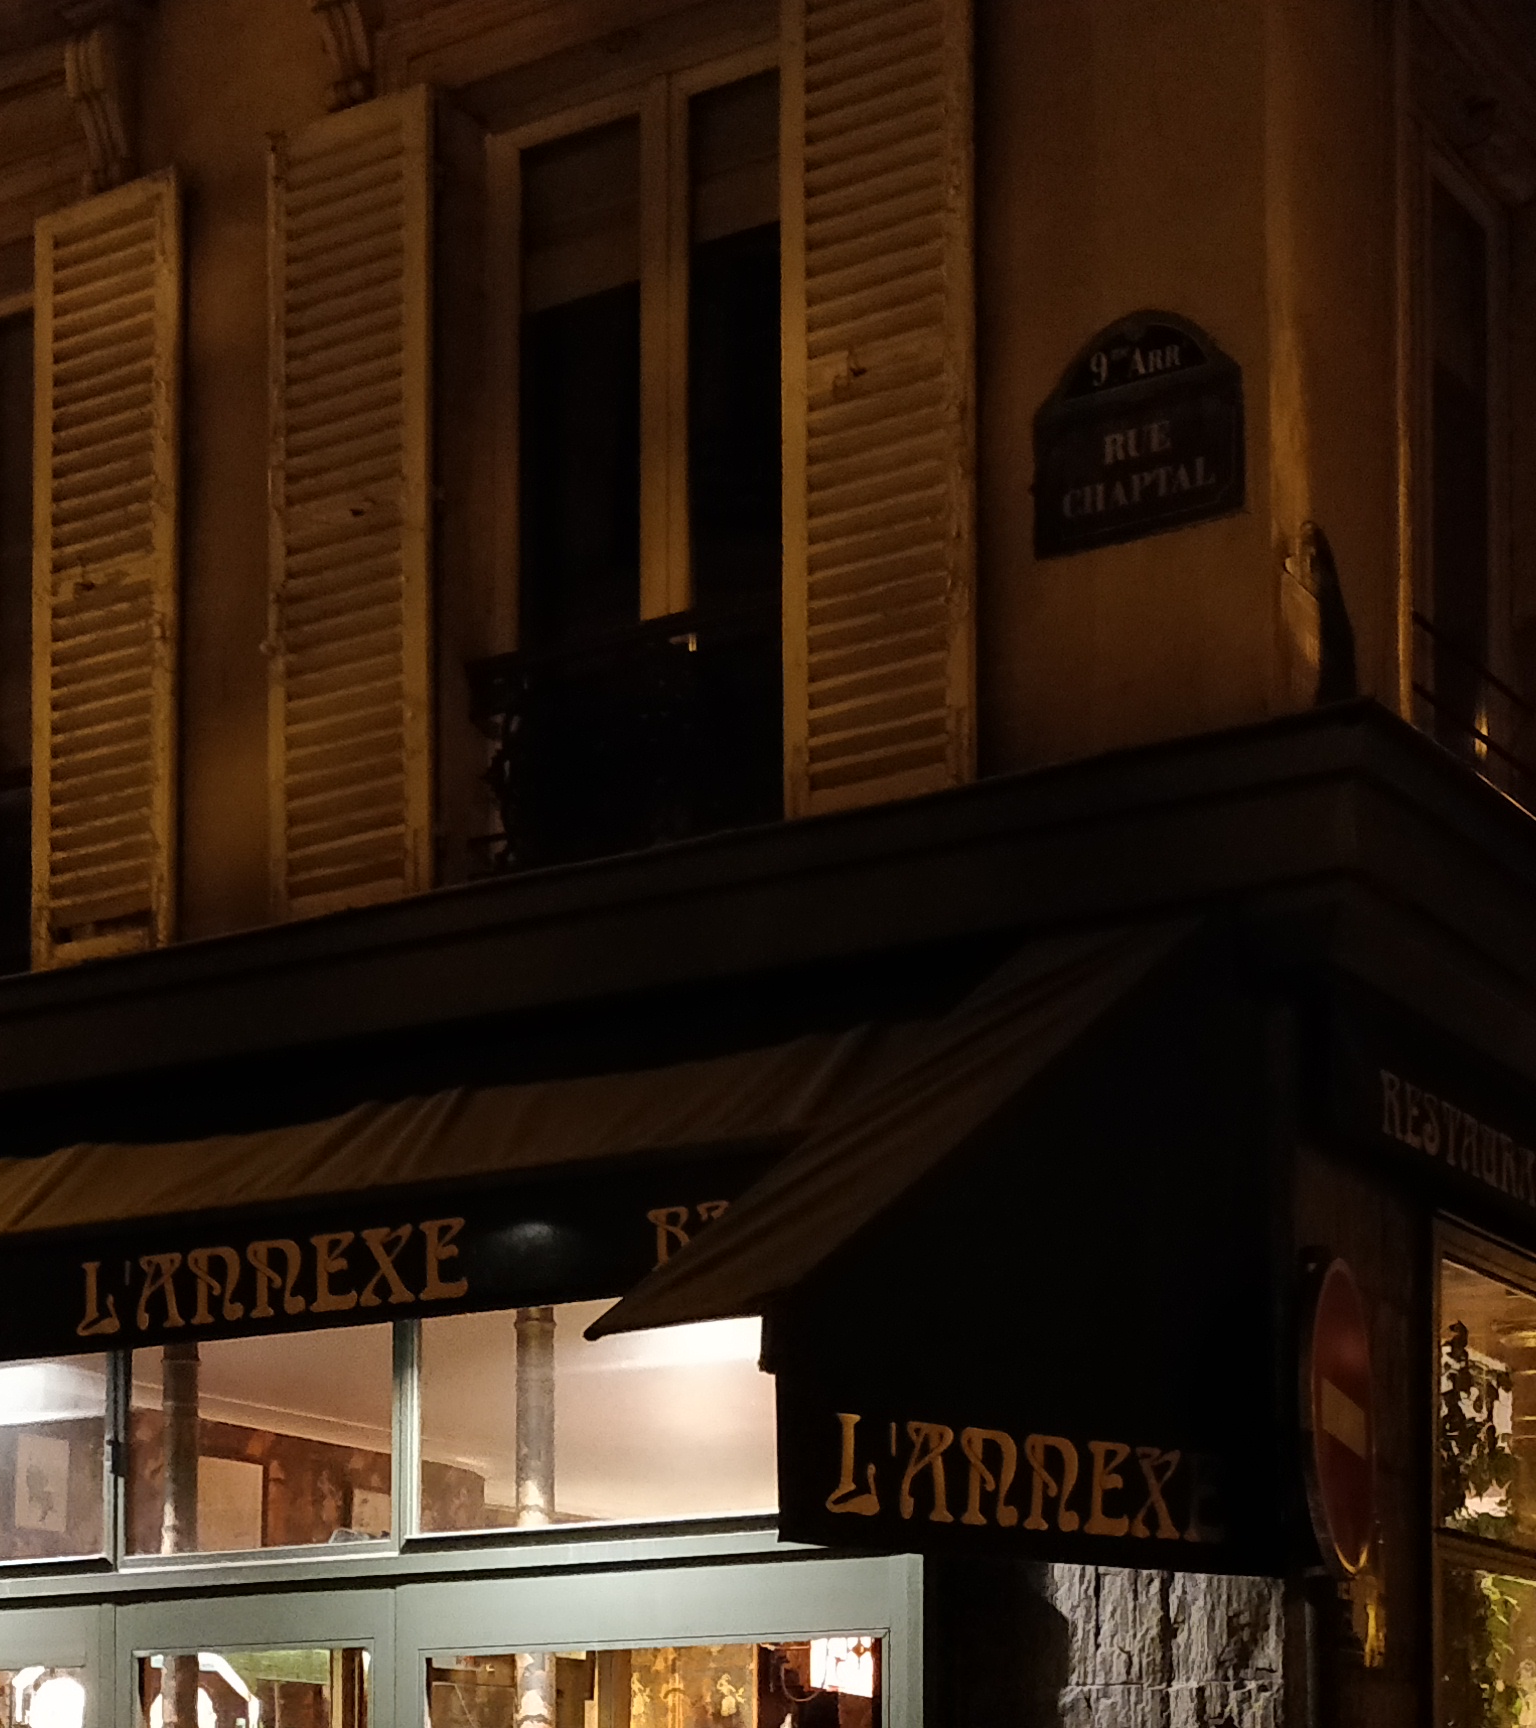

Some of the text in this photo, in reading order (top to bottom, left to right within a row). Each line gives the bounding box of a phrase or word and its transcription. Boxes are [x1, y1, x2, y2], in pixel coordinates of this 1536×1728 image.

[1103, 420, 1172, 466] RUE
[1062, 456, 1216, 518] CHAPTAL
[76, 1216, 469, 1337] L'ANNEXE
